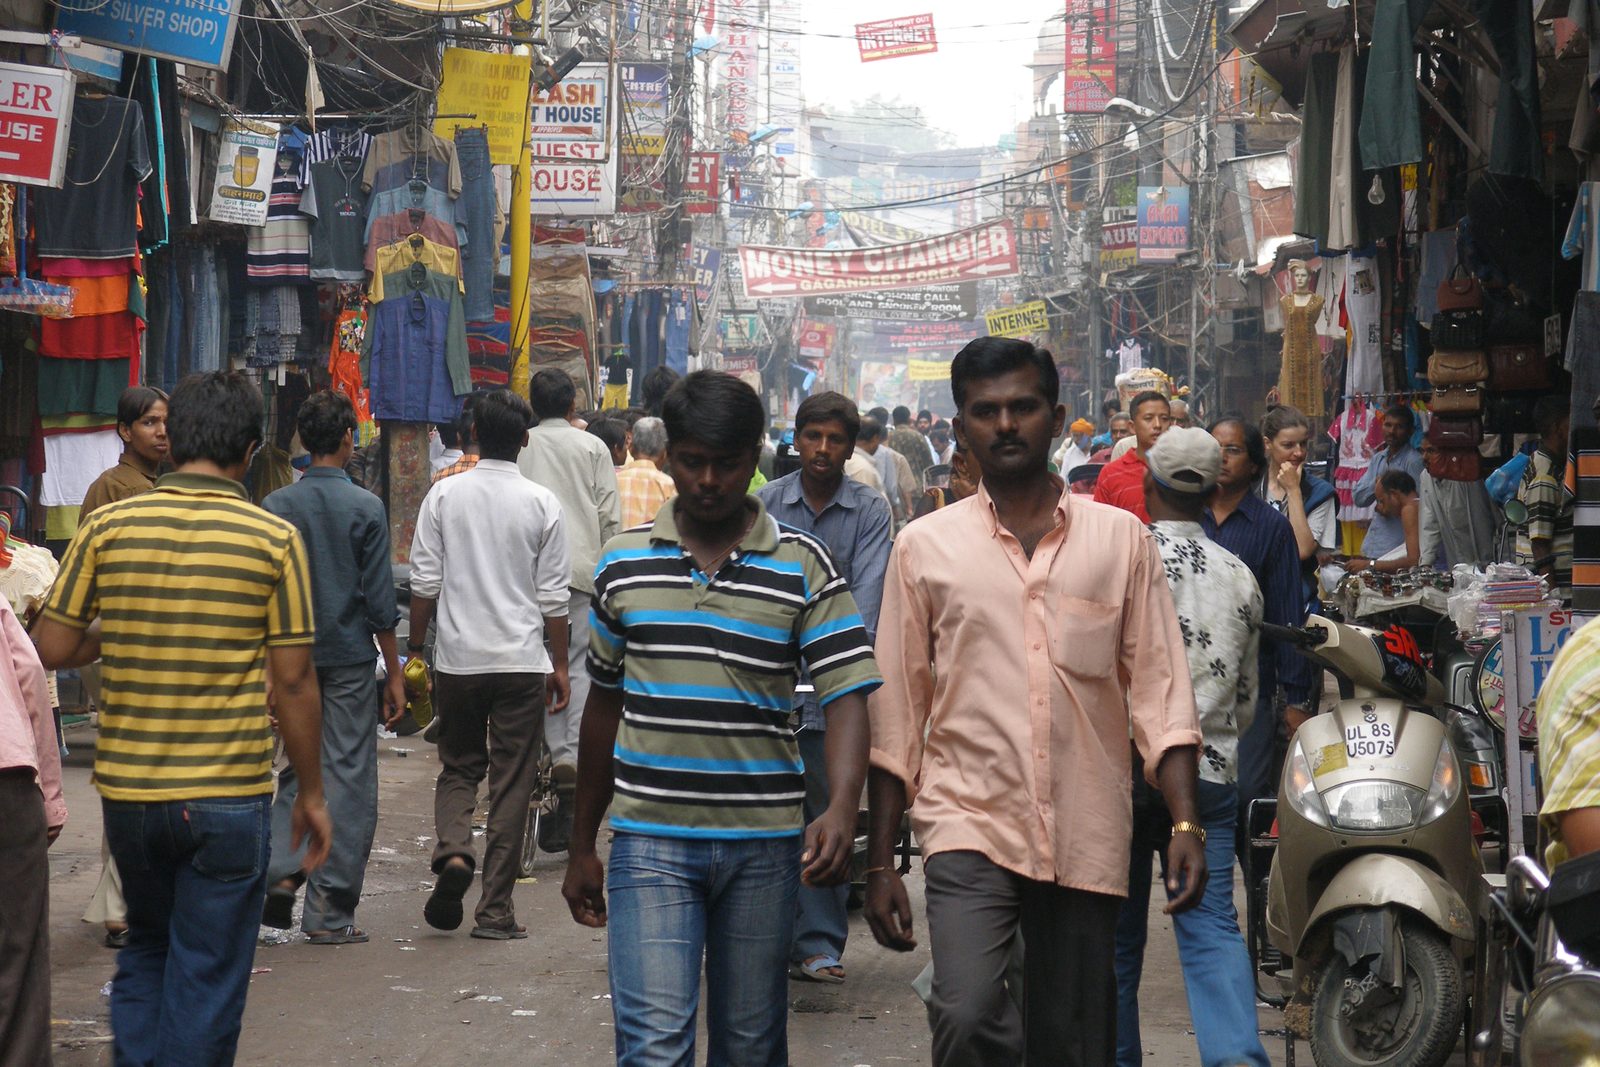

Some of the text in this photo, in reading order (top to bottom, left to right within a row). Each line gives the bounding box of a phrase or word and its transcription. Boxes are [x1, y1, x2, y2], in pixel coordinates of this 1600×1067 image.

[110, 1, 166, 29] SILVER
[168, 12, 219, 45] SHOP)
[860, 23, 932, 50] INTERNET
[545, 106, 602, 123] HOUSE
[536, 126, 563, 134] APPROVED
[531, 169, 602, 192] OUSE
[1140, 226, 1187, 246] EXPORTS
[746, 249, 852, 279] MONEY
[863, 225, 1011, 272] CHANGER
[800, 264, 962, 292] GAGANDEEP FOREX
[816, 297, 845, 306] POOL
[849, 300, 873, 308] AND
[931, 303, 963, 312] ROOM
[923, 293, 951, 302] CALL
[989, 308, 1046, 333] INTERNET
